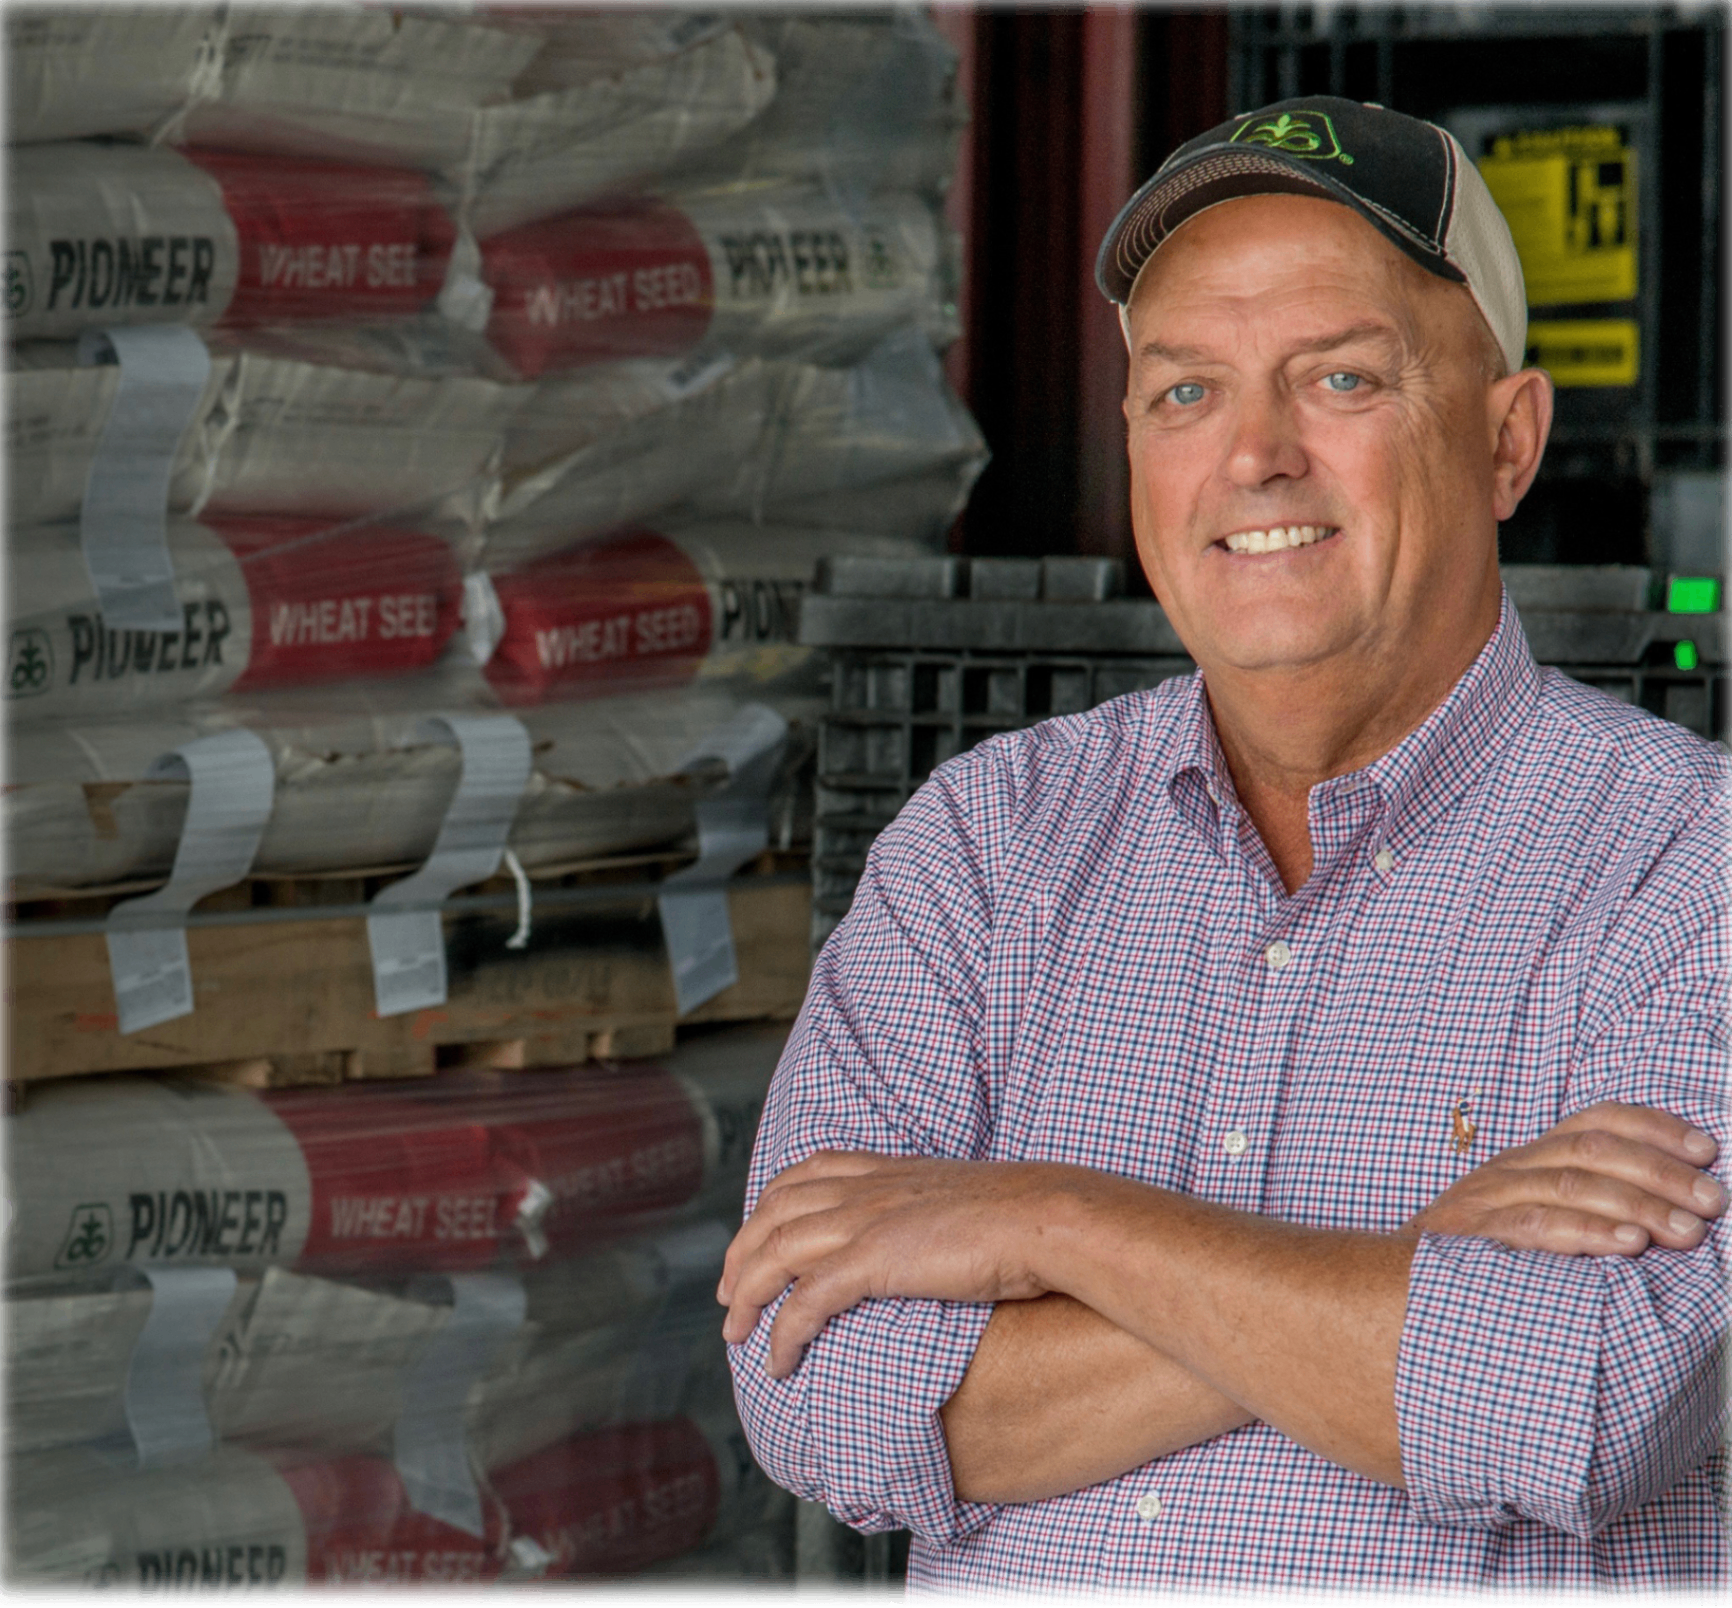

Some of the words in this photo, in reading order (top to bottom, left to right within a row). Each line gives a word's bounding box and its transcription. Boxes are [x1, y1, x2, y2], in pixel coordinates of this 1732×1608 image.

[47, 236, 214, 310] PIONEER
[259, 245, 361, 288] WHEAT
[525, 273, 628, 327] WHEAT
[635, 263, 700, 311] SEED
[270, 599, 374, 645] WHEAT
[535, 615, 632, 669] WHEAT
[635, 604, 701, 654] SEED
[127, 1189, 288, 1259] PIONEER
[330, 1197, 428, 1239] WHEAT
[137, 1544, 288, 1605] PIONEER
[322, 1550, 417, 1594] WHEAT
